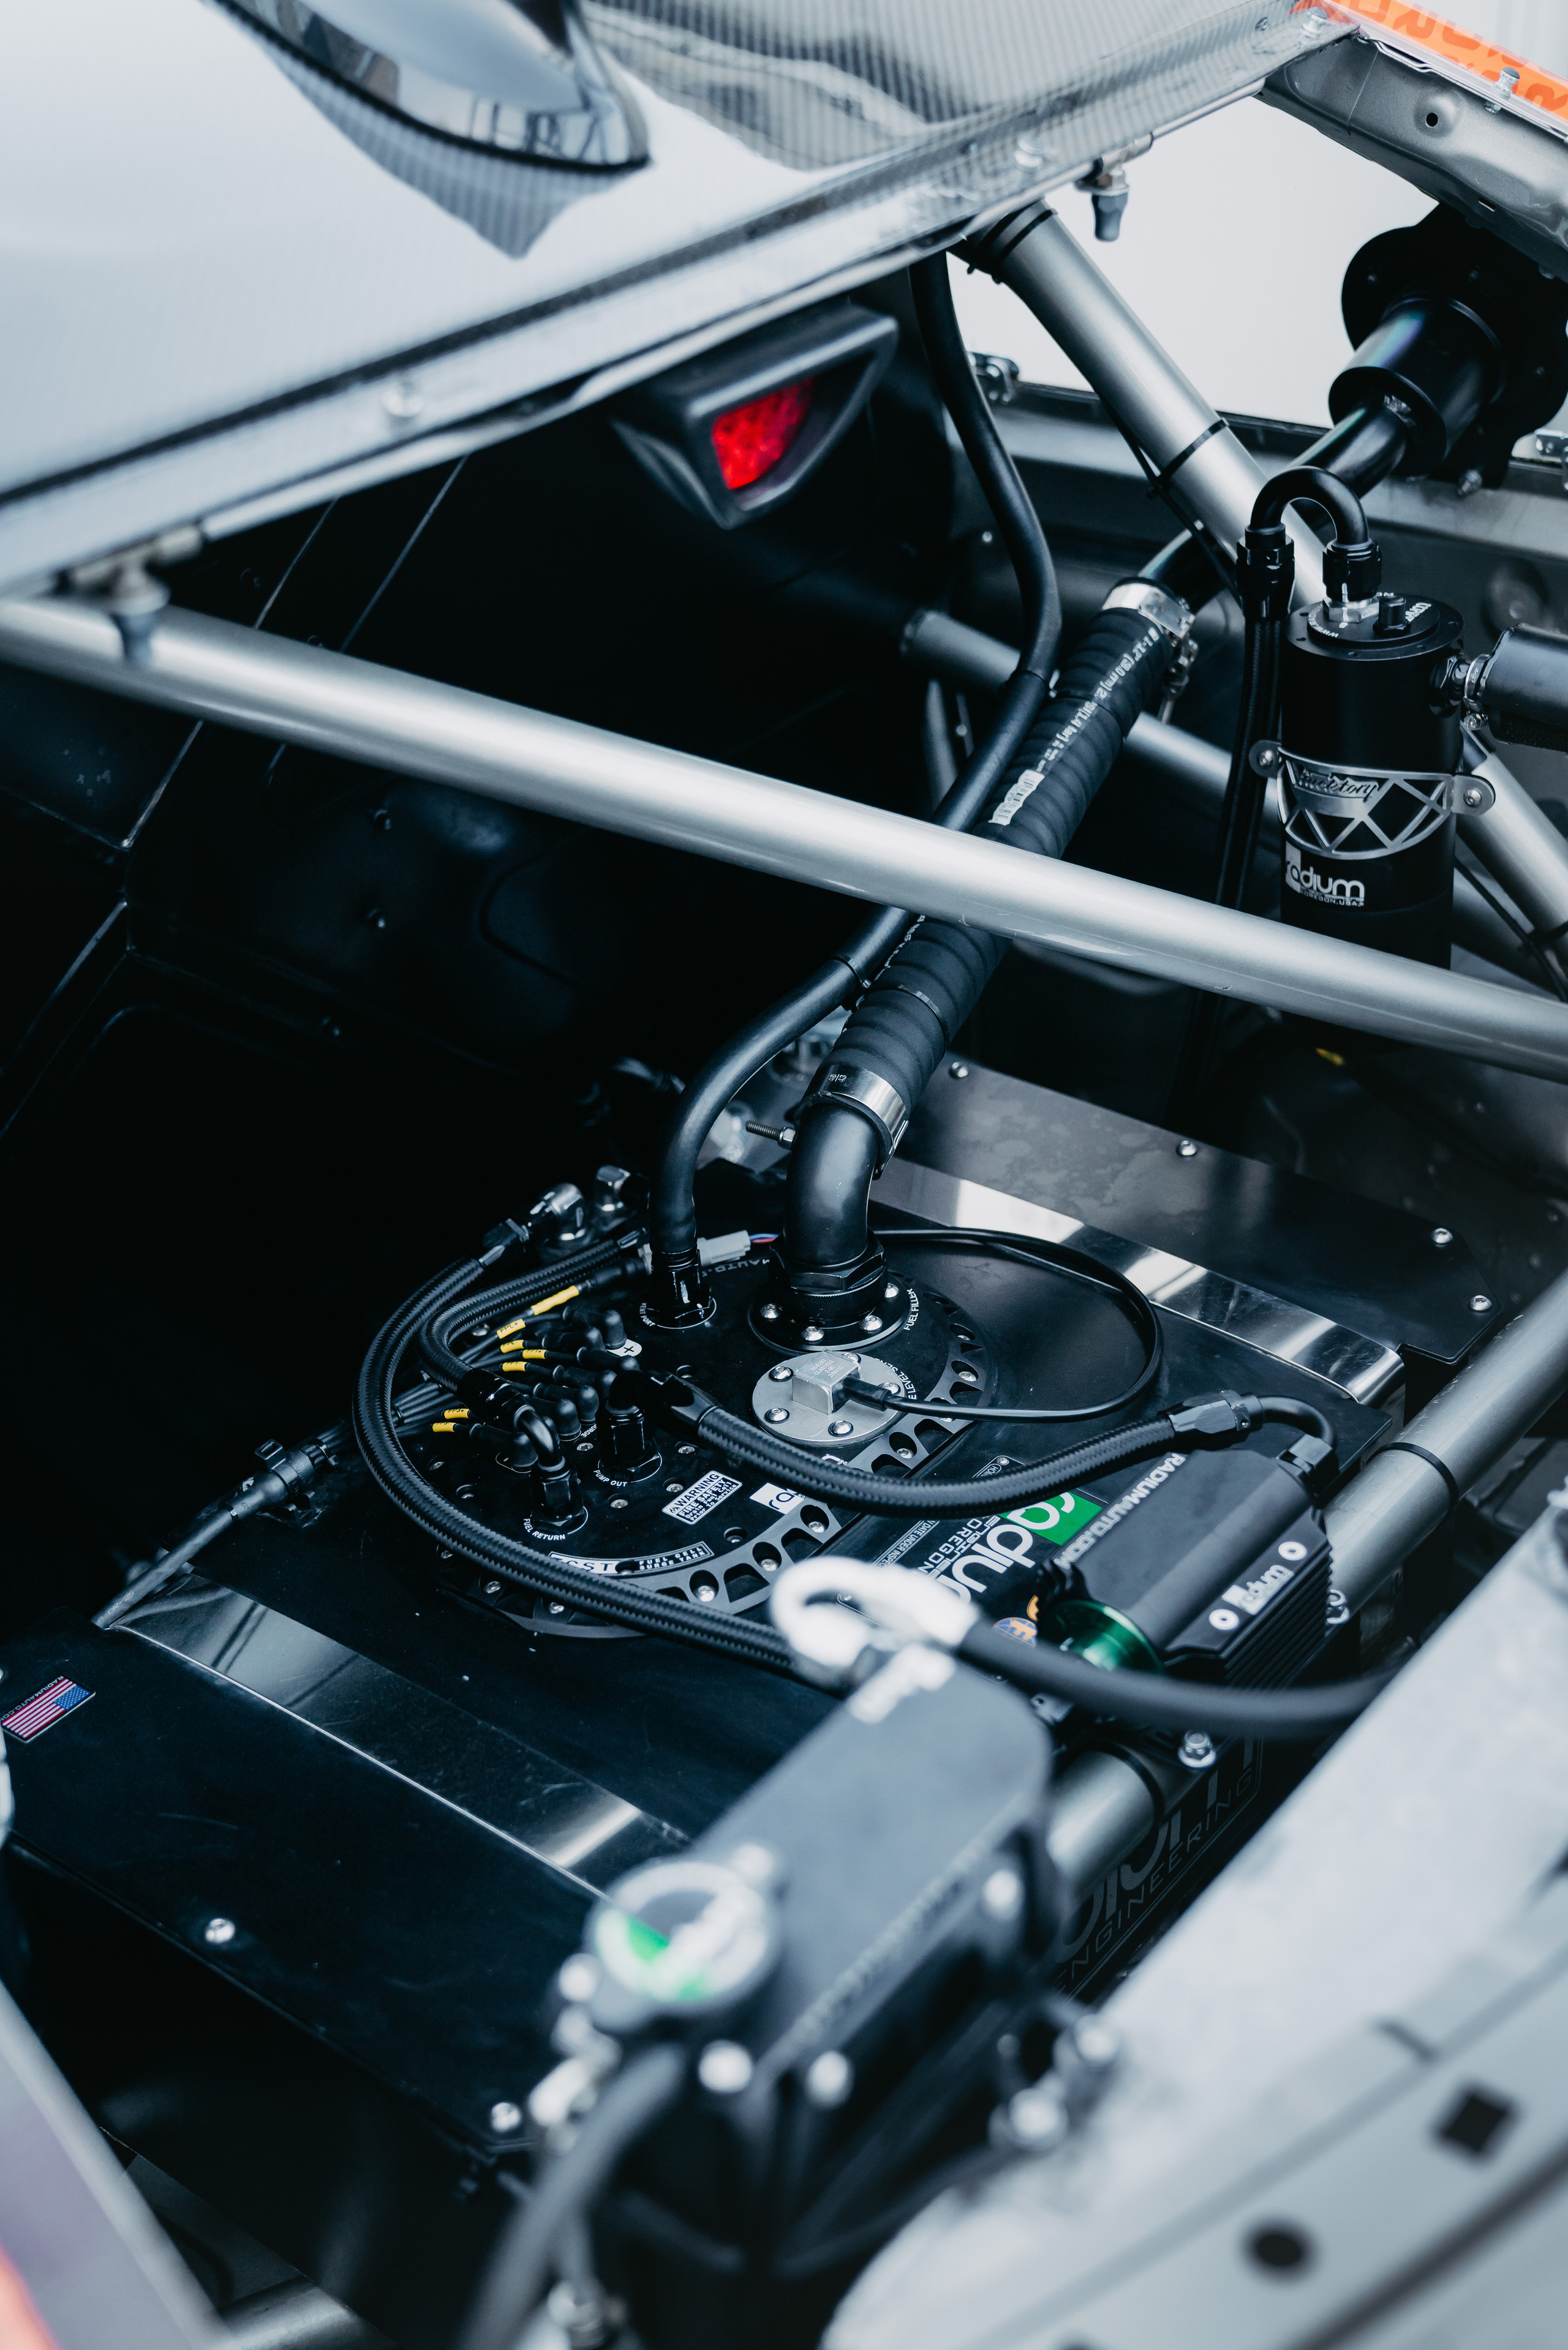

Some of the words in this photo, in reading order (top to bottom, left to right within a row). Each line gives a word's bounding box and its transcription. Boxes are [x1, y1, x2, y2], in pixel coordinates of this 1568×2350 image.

[907, 1288, 919, 1311] FILLER
[640, 1315, 655, 1327] PORT
[903, 1313, 918, 1330] FUEL
[898, 1371, 916, 1395] LEVEL
[594, 1469, 610, 1483] PUMP
[674, 1474, 720, 1507] WARNING
[679, 1501, 699, 1517] FIRE
[697, 1479, 726, 1502] SAFETY
[685, 1505, 704, 1519] Drain
[703, 1494, 717, 1505] Fuel
[718, 1482, 732, 1493] Cell
[690, 1508, 706, 1521] Prior
[714, 1484, 737, 1501] Service
[1054, 1453, 1186, 1569] RADIUMAUTO.COM
[532, 1531, 566, 1541] RETURN
[914, 1521, 932, 1537] DATE
[896, 1533, 919, 1553] UNDER
[918, 1519, 982, 1574] OREGON
[639, 1557, 668, 1565] FUEL
[674, 1546, 703, 1559] CELL
[639, 1560, 674, 1570] SURGE
[679, 1551, 705, 1562] TANK
[108, 1591, 134, 1615] DR-25
